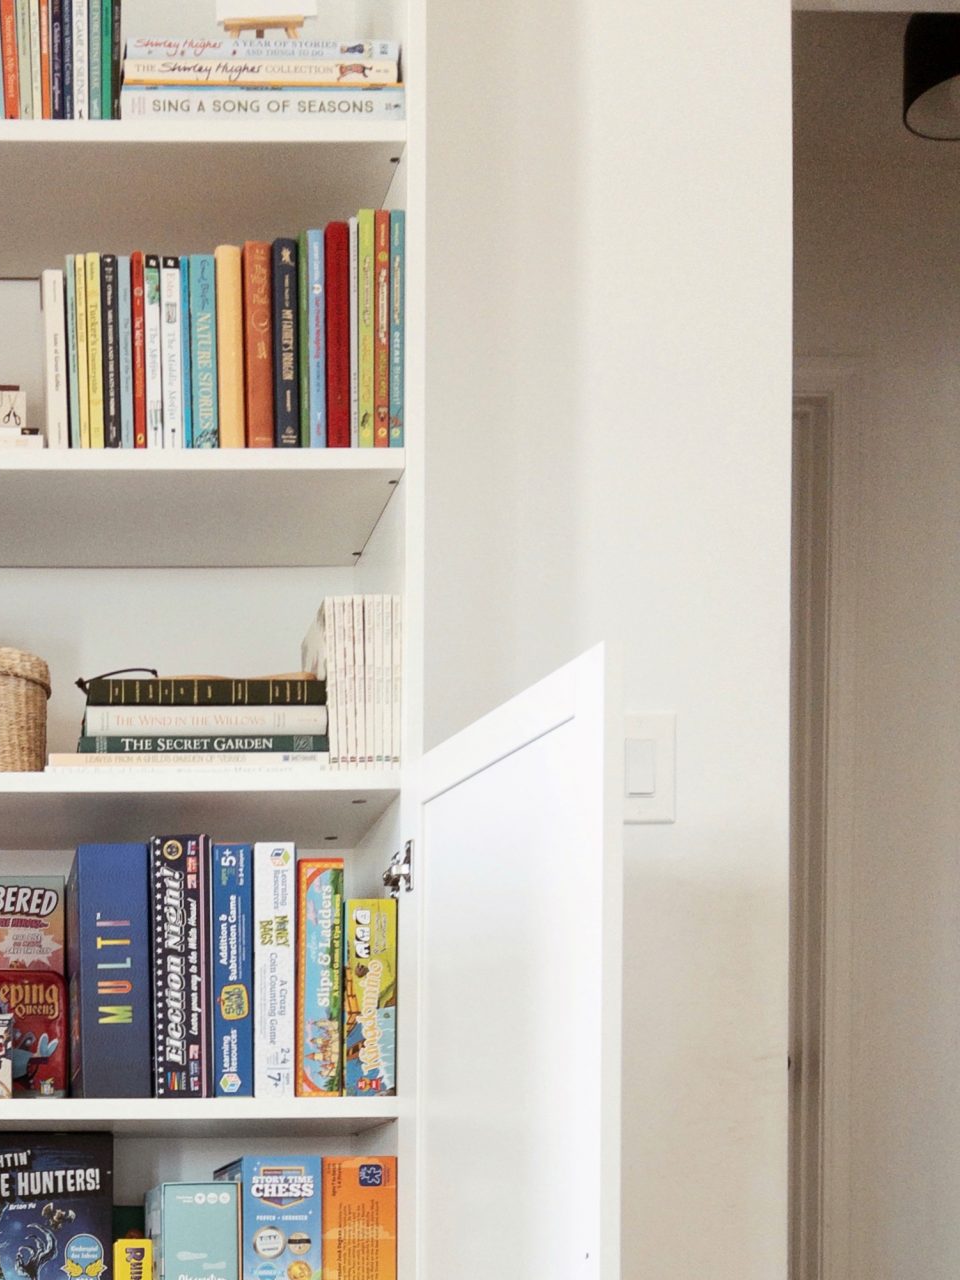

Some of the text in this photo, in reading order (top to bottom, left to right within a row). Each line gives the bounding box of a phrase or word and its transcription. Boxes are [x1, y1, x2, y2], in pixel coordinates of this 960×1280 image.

[134, 39, 222, 57] Shirley Hughes
[136, 62, 333, 81] THE Shirley Hughes COLLECTION
[153, 100, 375, 113] SING A SONG OF SEASONS
[282, 309, 294, 381] MY FATHER'S DRAGON
[197, 312, 213, 430] NATURE STORIES
[115, 714, 266, 727] THE WIND IN THE WILLOWS
[120, 737, 273, 751] THE SECRET GARDEN
[222, 848, 236, 867] 5+
[273, 868, 281, 910] Resources
[280, 868, 288, 906] Learning
[219, 914, 228, 966] Addition &
[229, 895, 239, 982] Subtraction Game
[259, 919, 273, 946] BAGS
[317, 884, 332, 1008] Slips & Ladders
[96, 920, 133, 1024] MULTI
[159, 866, 187, 1066] Election Night!
[14, 1002, 57, 1019] Queens
[223, 990, 235, 1015] SUM
[234, 987, 244, 1016] SWAMP
[268, 952, 278, 1045] Coin Counting Game
[277, 979, 288, 1016] A Crazy
[358, 960, 384, 1075] Kingdomino
[221, 1036, 231, 1073] Learning
[230, 1029, 238, 1073] Resources
[267, 1072, 282, 1088] 7+
[17, 1168, 100, 1196] HUNTERS!
[251, 1175, 314, 1185] STORY TIME
[251, 1184, 314, 1198] CHESS
